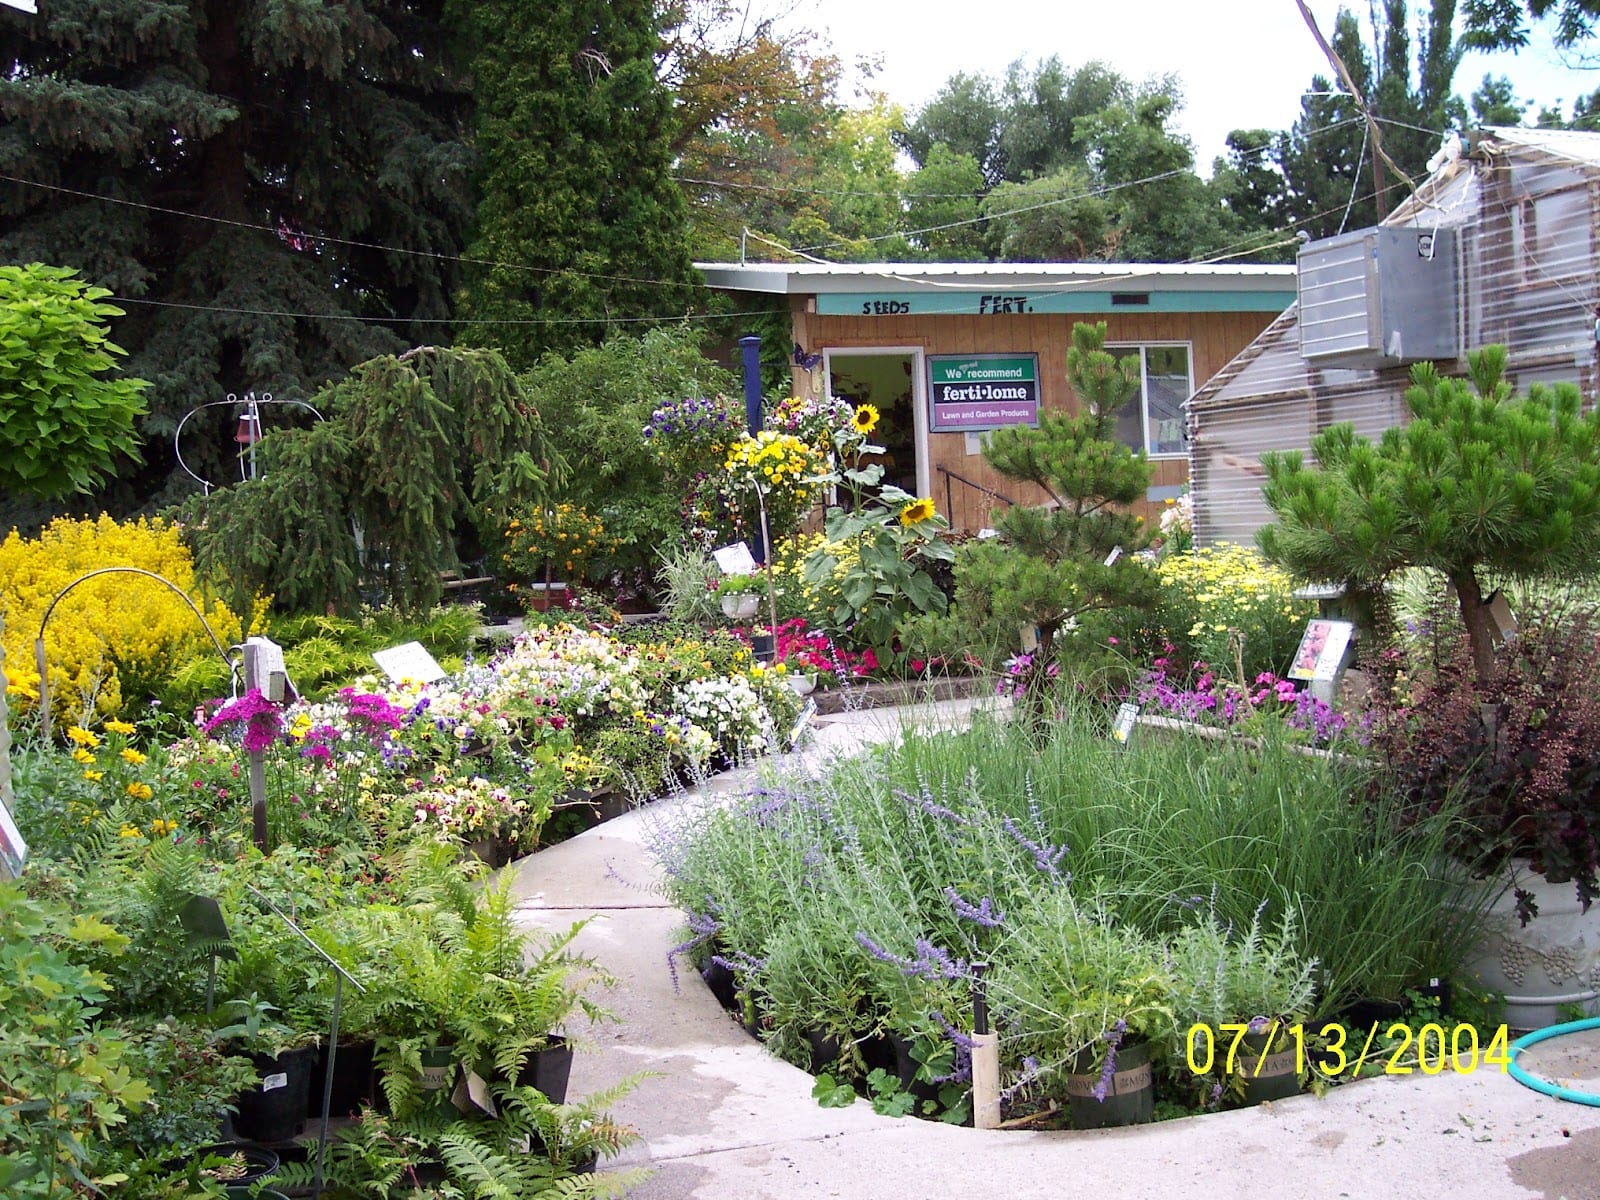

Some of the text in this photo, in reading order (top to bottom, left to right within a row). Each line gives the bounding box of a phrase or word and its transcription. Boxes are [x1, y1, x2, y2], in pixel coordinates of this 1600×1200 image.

[862, 300, 911, 315] SEEDS
[945, 367, 1022, 379] We recommend
[942, 408, 1030, 419] Lawn and Garden Products
